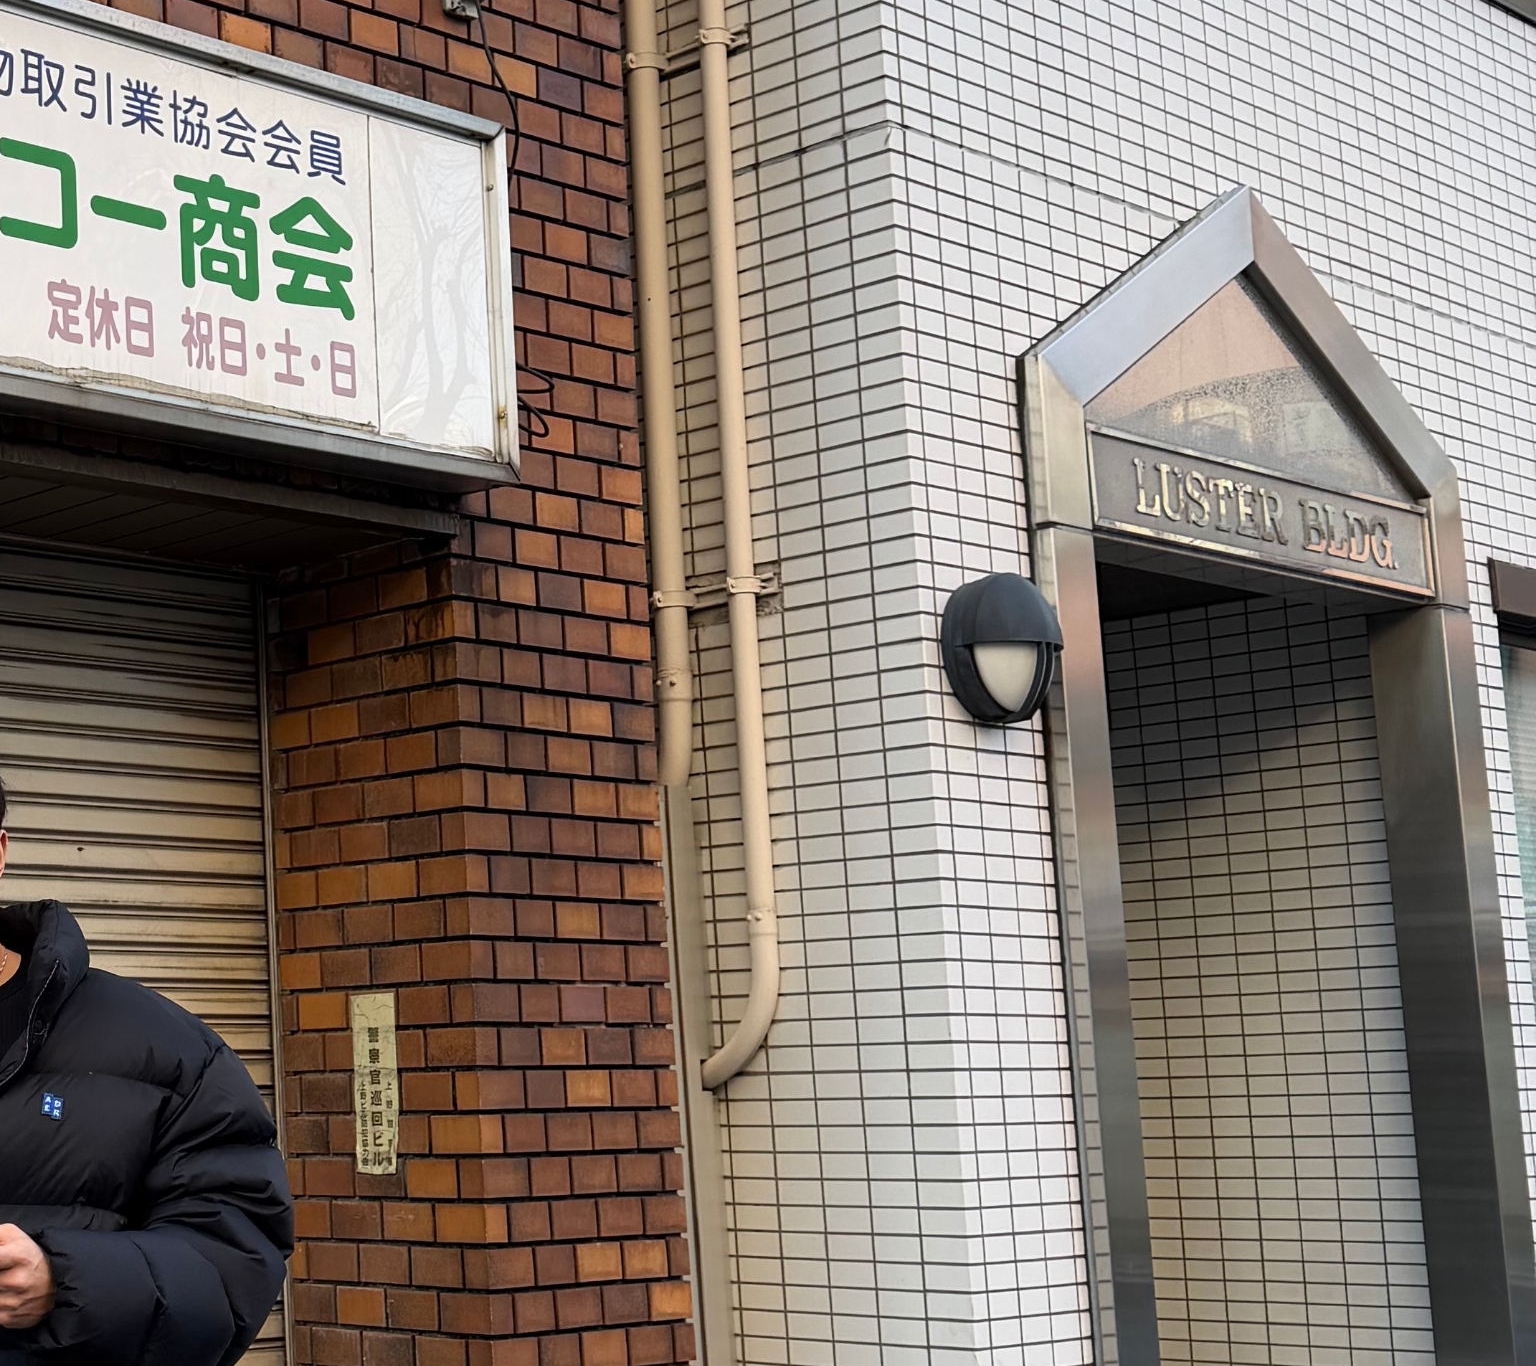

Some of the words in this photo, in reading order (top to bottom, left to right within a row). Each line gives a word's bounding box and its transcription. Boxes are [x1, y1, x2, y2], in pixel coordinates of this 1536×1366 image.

[47, 279, 155, 357] 定休日
[1132, 457, 1288, 546] LUSTER
[1299, 498, 1400, 570] BLDG.
